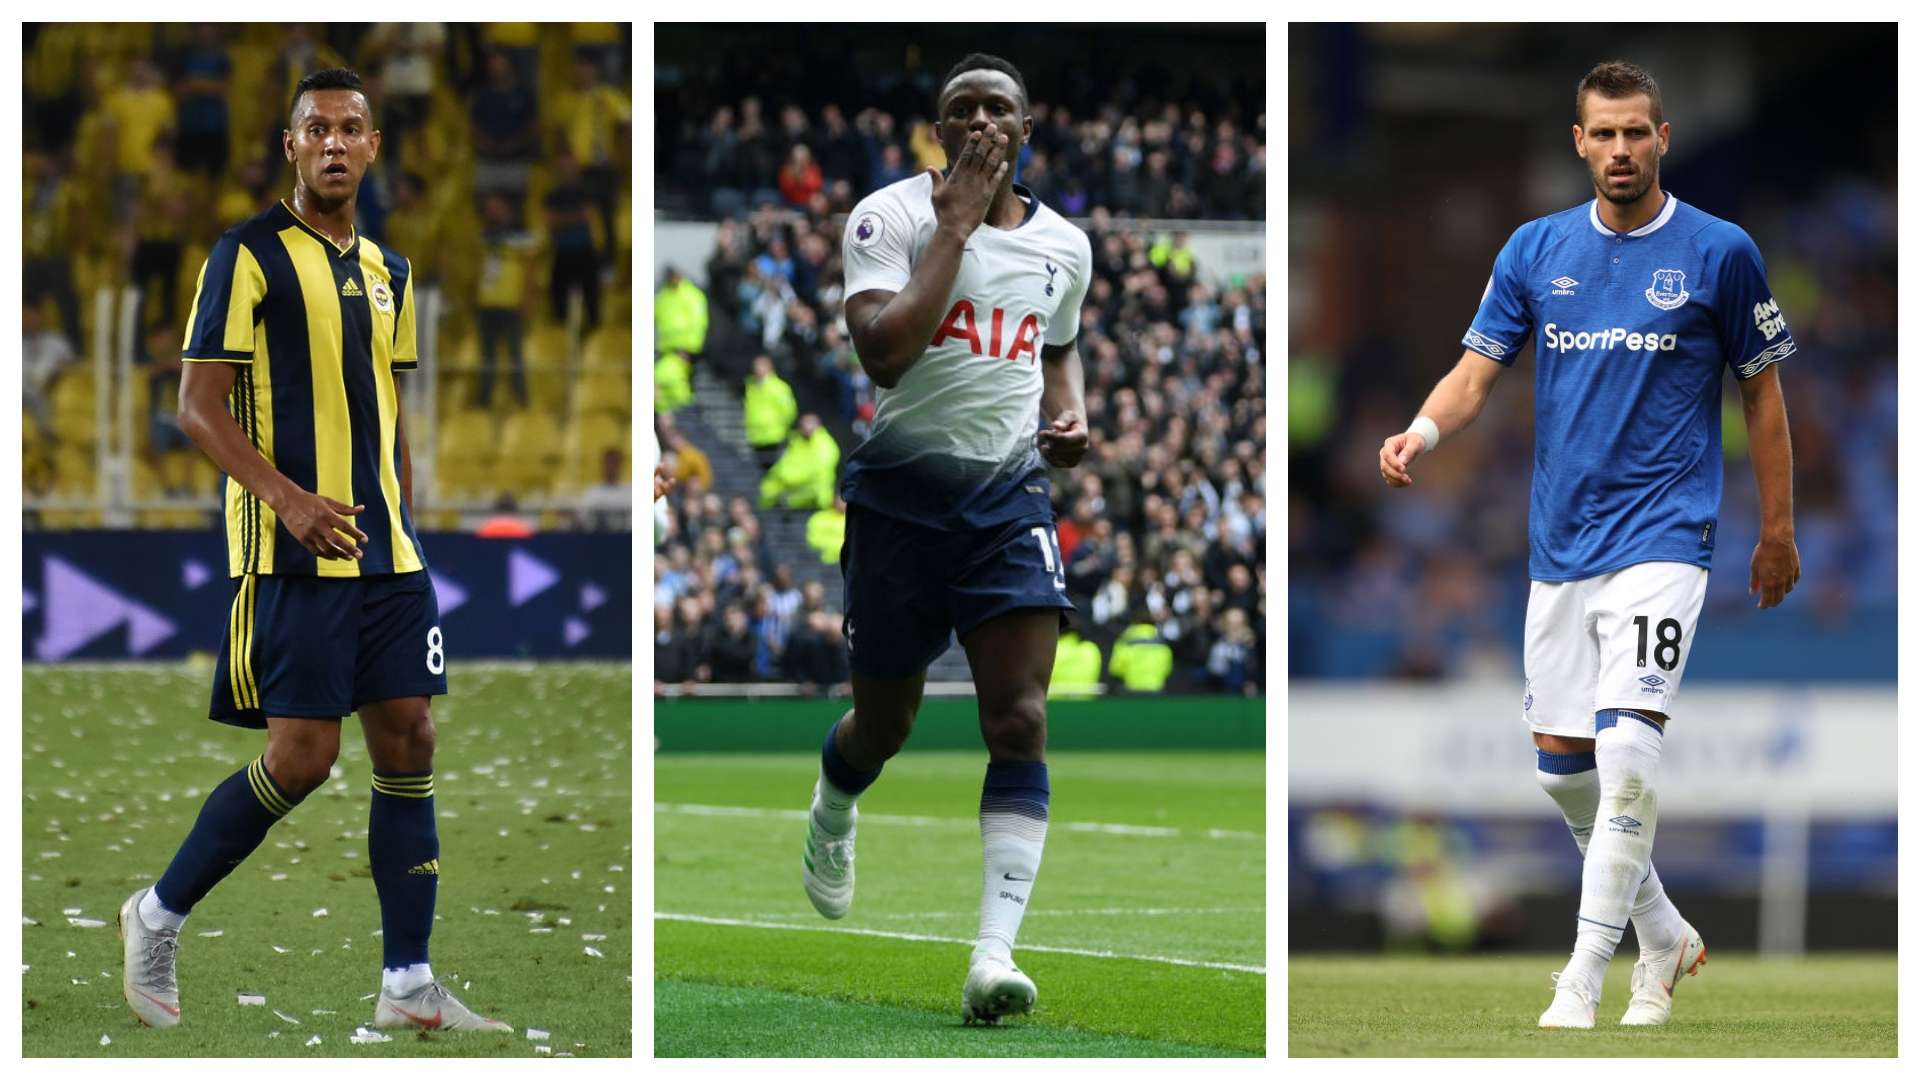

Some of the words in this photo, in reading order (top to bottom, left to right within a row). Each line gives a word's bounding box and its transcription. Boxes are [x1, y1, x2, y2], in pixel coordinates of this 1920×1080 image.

[341, 289, 363, 297] adidas
[1551, 288, 1575, 296] umbro
[1753, 297, 1779, 327] AN
[929, 299, 1040, 366] AIA
[1544, 322, 1678, 354] SportPesa
[426, 626, 445, 675] 8
[1632, 615, 1683, 672] 18
[1641, 686, 1665, 694] umbro
